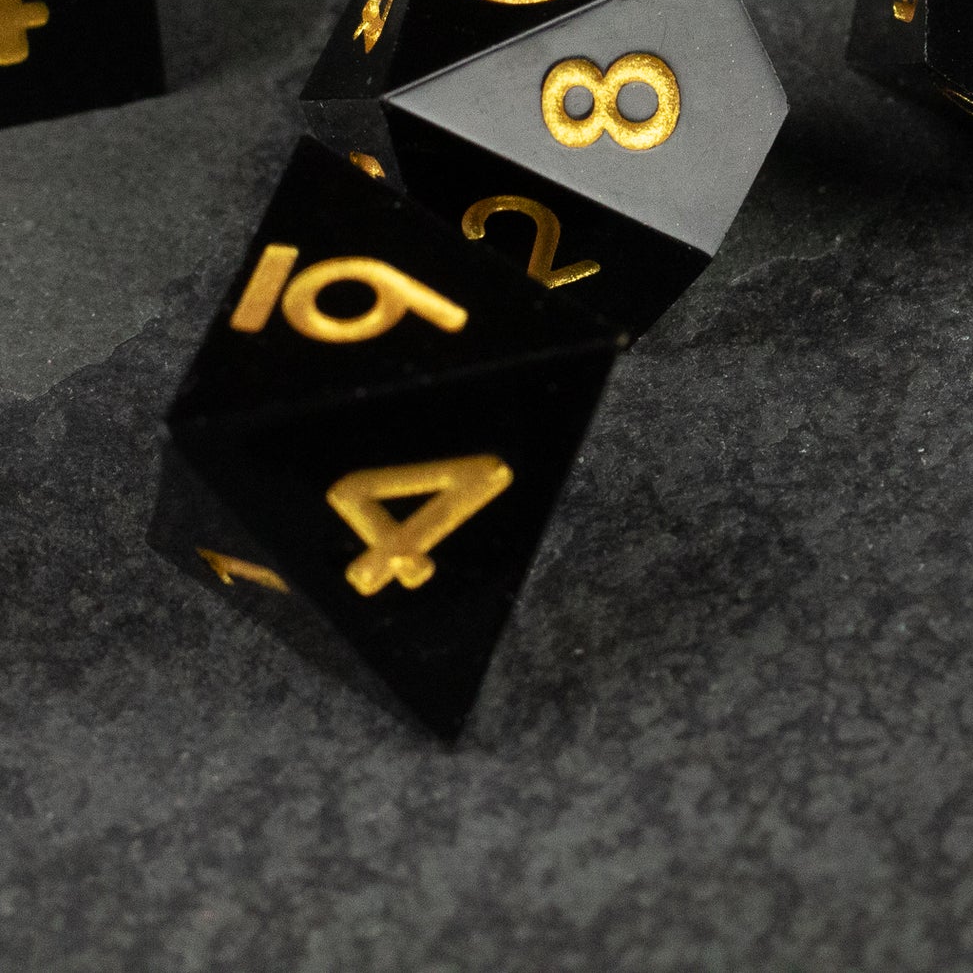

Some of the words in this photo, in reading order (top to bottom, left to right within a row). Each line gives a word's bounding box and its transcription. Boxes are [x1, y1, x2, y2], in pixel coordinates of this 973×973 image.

[541, 52, 682, 151] 8
[461, 194, 601, 289] 2
[325, 454, 514, 597] 4
